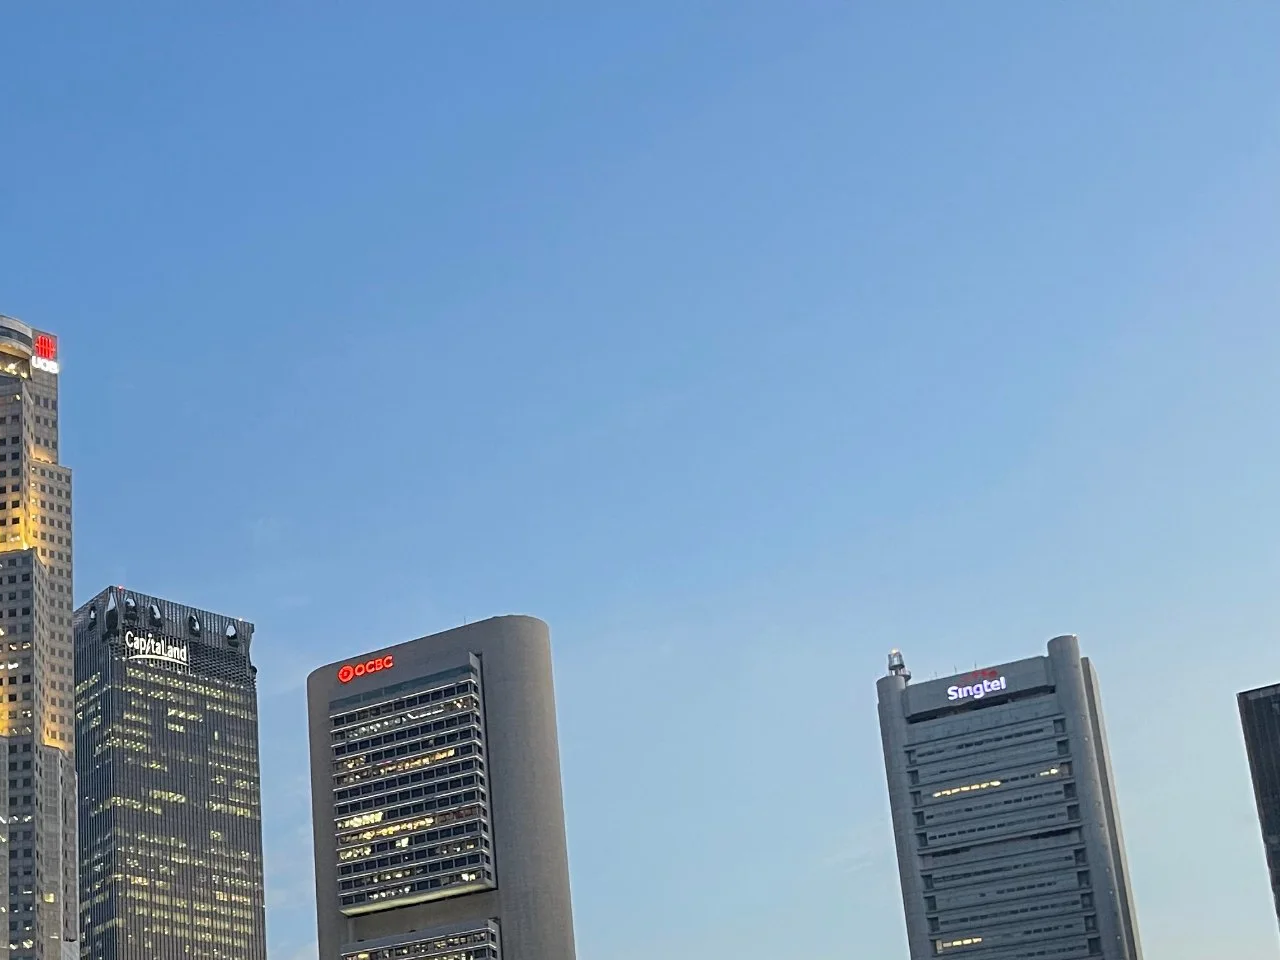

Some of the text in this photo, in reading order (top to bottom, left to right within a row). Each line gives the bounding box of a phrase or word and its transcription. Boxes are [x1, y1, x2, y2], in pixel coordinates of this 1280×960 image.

[125, 631, 187, 661] CapitaLand
[354, 655, 394, 676] OCBC
[947, 676, 1007, 700] Singtel
